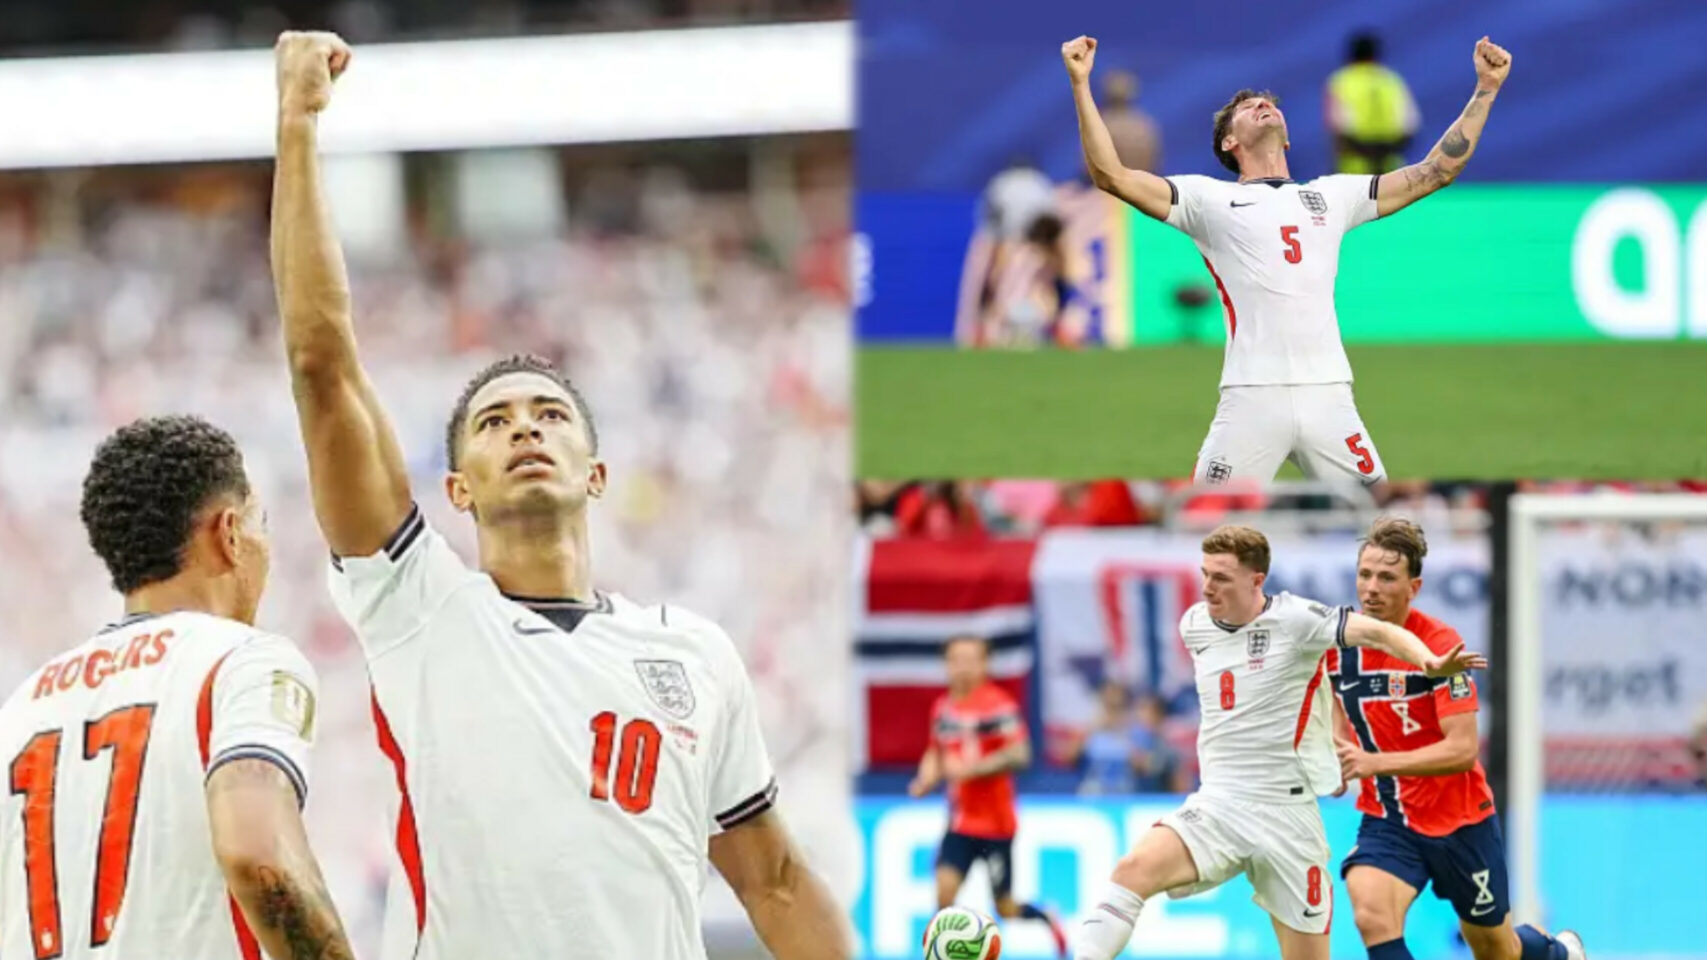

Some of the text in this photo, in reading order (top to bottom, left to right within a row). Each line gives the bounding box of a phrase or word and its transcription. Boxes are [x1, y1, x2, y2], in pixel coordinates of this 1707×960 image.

[1280, 226, 1302, 264] 5
[1345, 433, 1375, 475] 5
[1220, 669, 1236, 711] 8
[1390, 701, 1422, 736] 8
[589, 711, 662, 815] 10
[9, 702, 157, 960] 17
[1306, 865, 1322, 907] 8
[1472, 869, 1495, 905] 8
